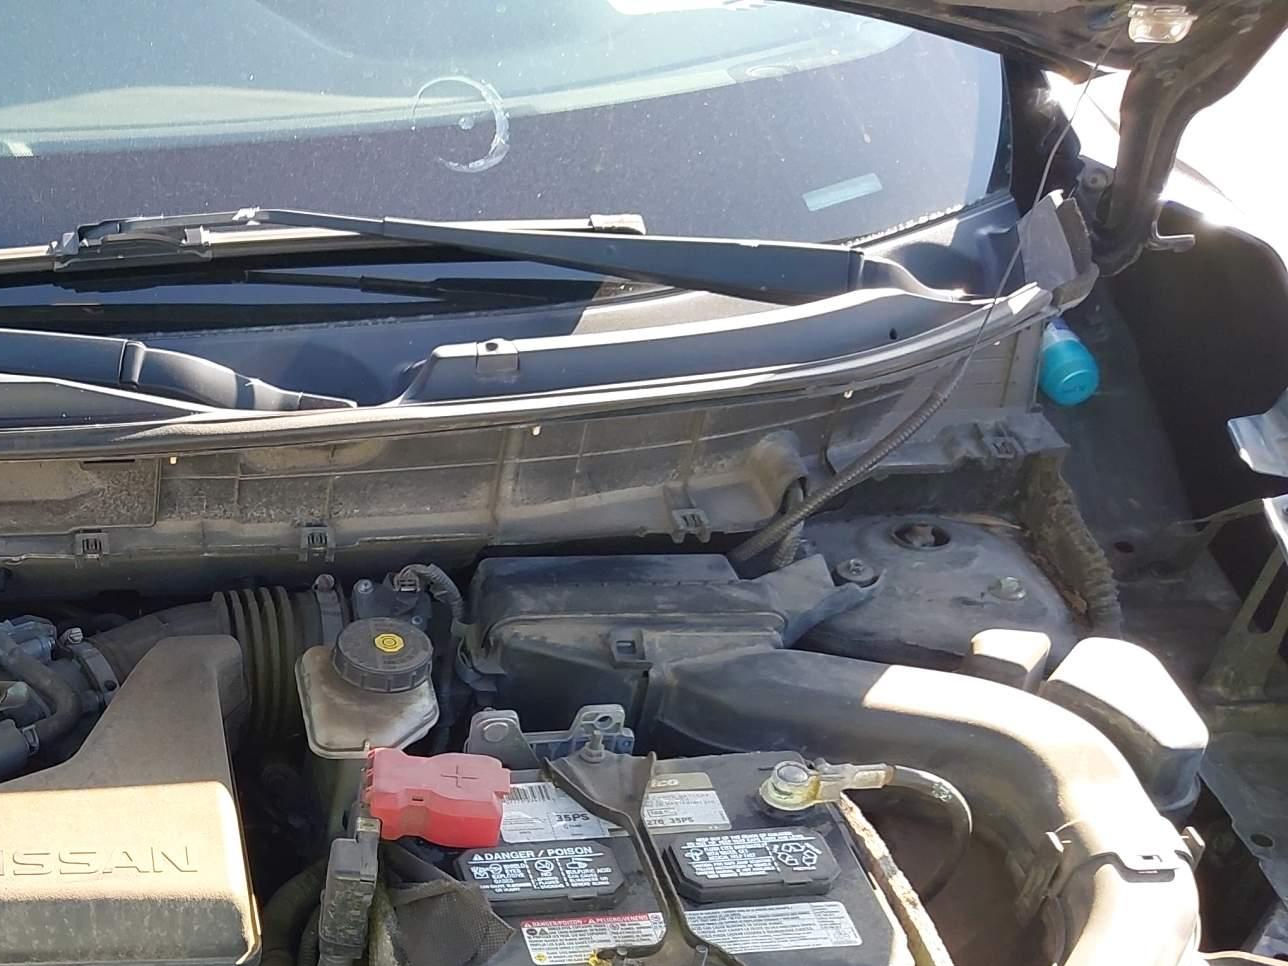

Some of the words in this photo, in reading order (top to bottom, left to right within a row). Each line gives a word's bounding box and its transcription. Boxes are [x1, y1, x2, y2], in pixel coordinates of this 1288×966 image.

[556, 813, 590, 822] 35PS
[485, 850, 535, 861] DANGER
[547, 846, 593, 857] POISON
